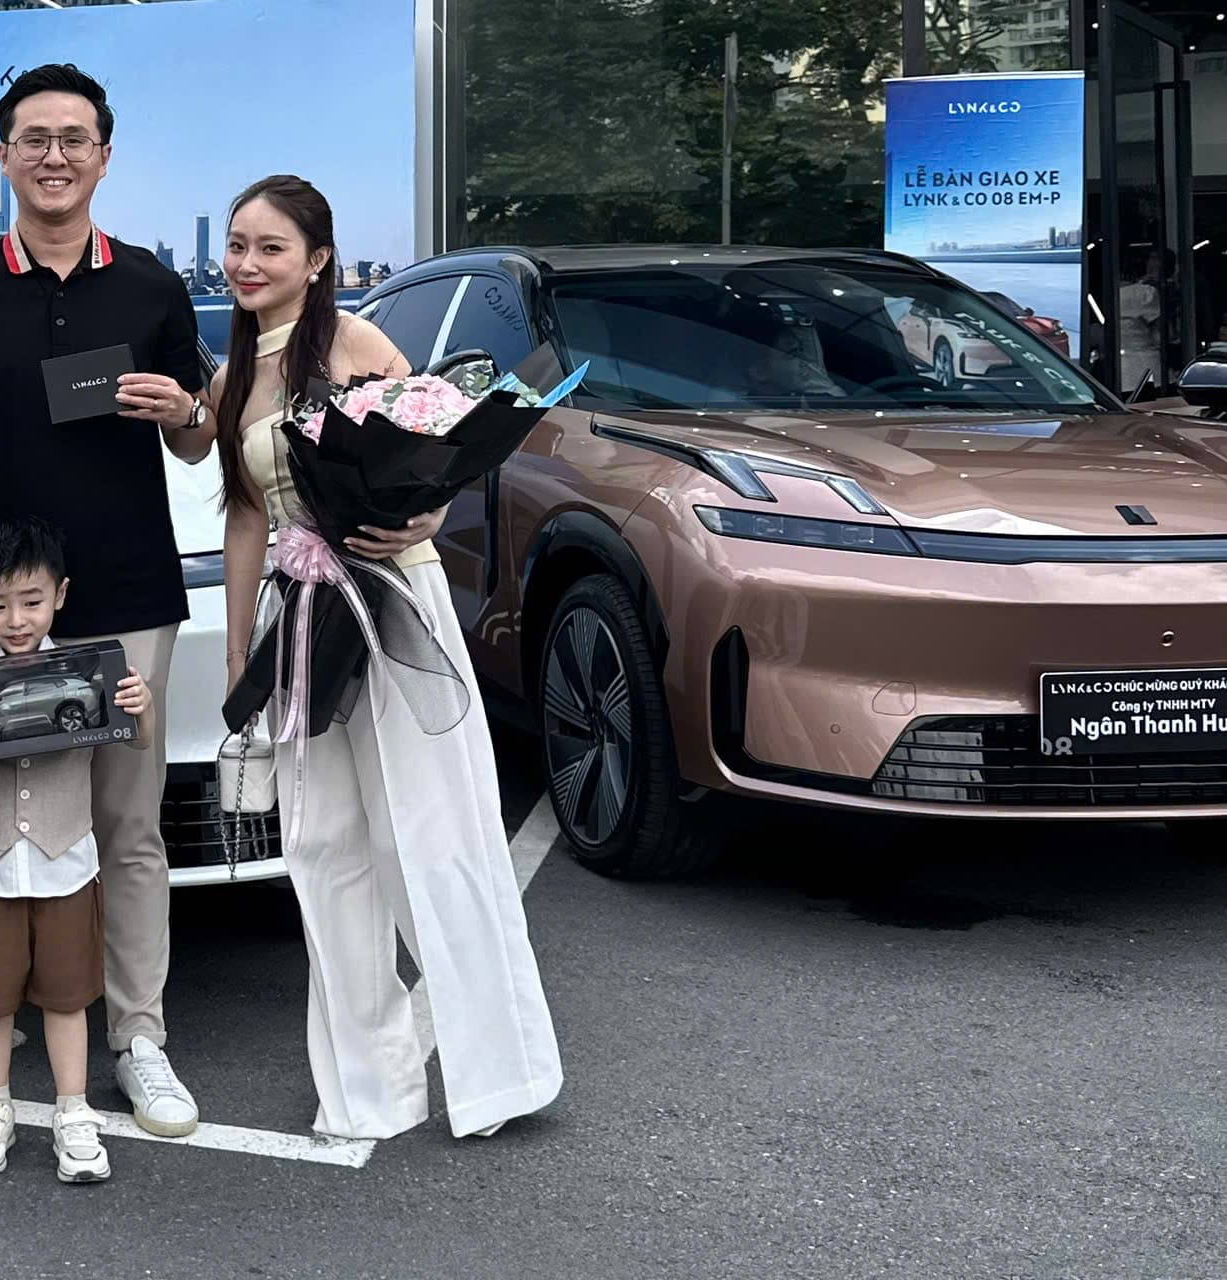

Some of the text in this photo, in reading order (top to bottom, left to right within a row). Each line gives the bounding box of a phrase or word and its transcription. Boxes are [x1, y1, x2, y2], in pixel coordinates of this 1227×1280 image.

[905, 165, 1060, 187] LỄ BÀN GIAO XE
[904, 191, 1061, 207] LYNK & CO 08 EM-P
[1113, 679, 1144, 693] CHÚC
[1145, 678, 1178, 692] MỪNG
[1179, 677, 1203, 691] QUÝ
[1204, 676, 1227, 690] KHÁ
[1111, 697, 1217, 714] Công ty TNHH MTV
[113, 727, 132, 739] 08
[1070, 716, 1127, 741] Ngân
[1130, 713, 1197, 734] Thanh
